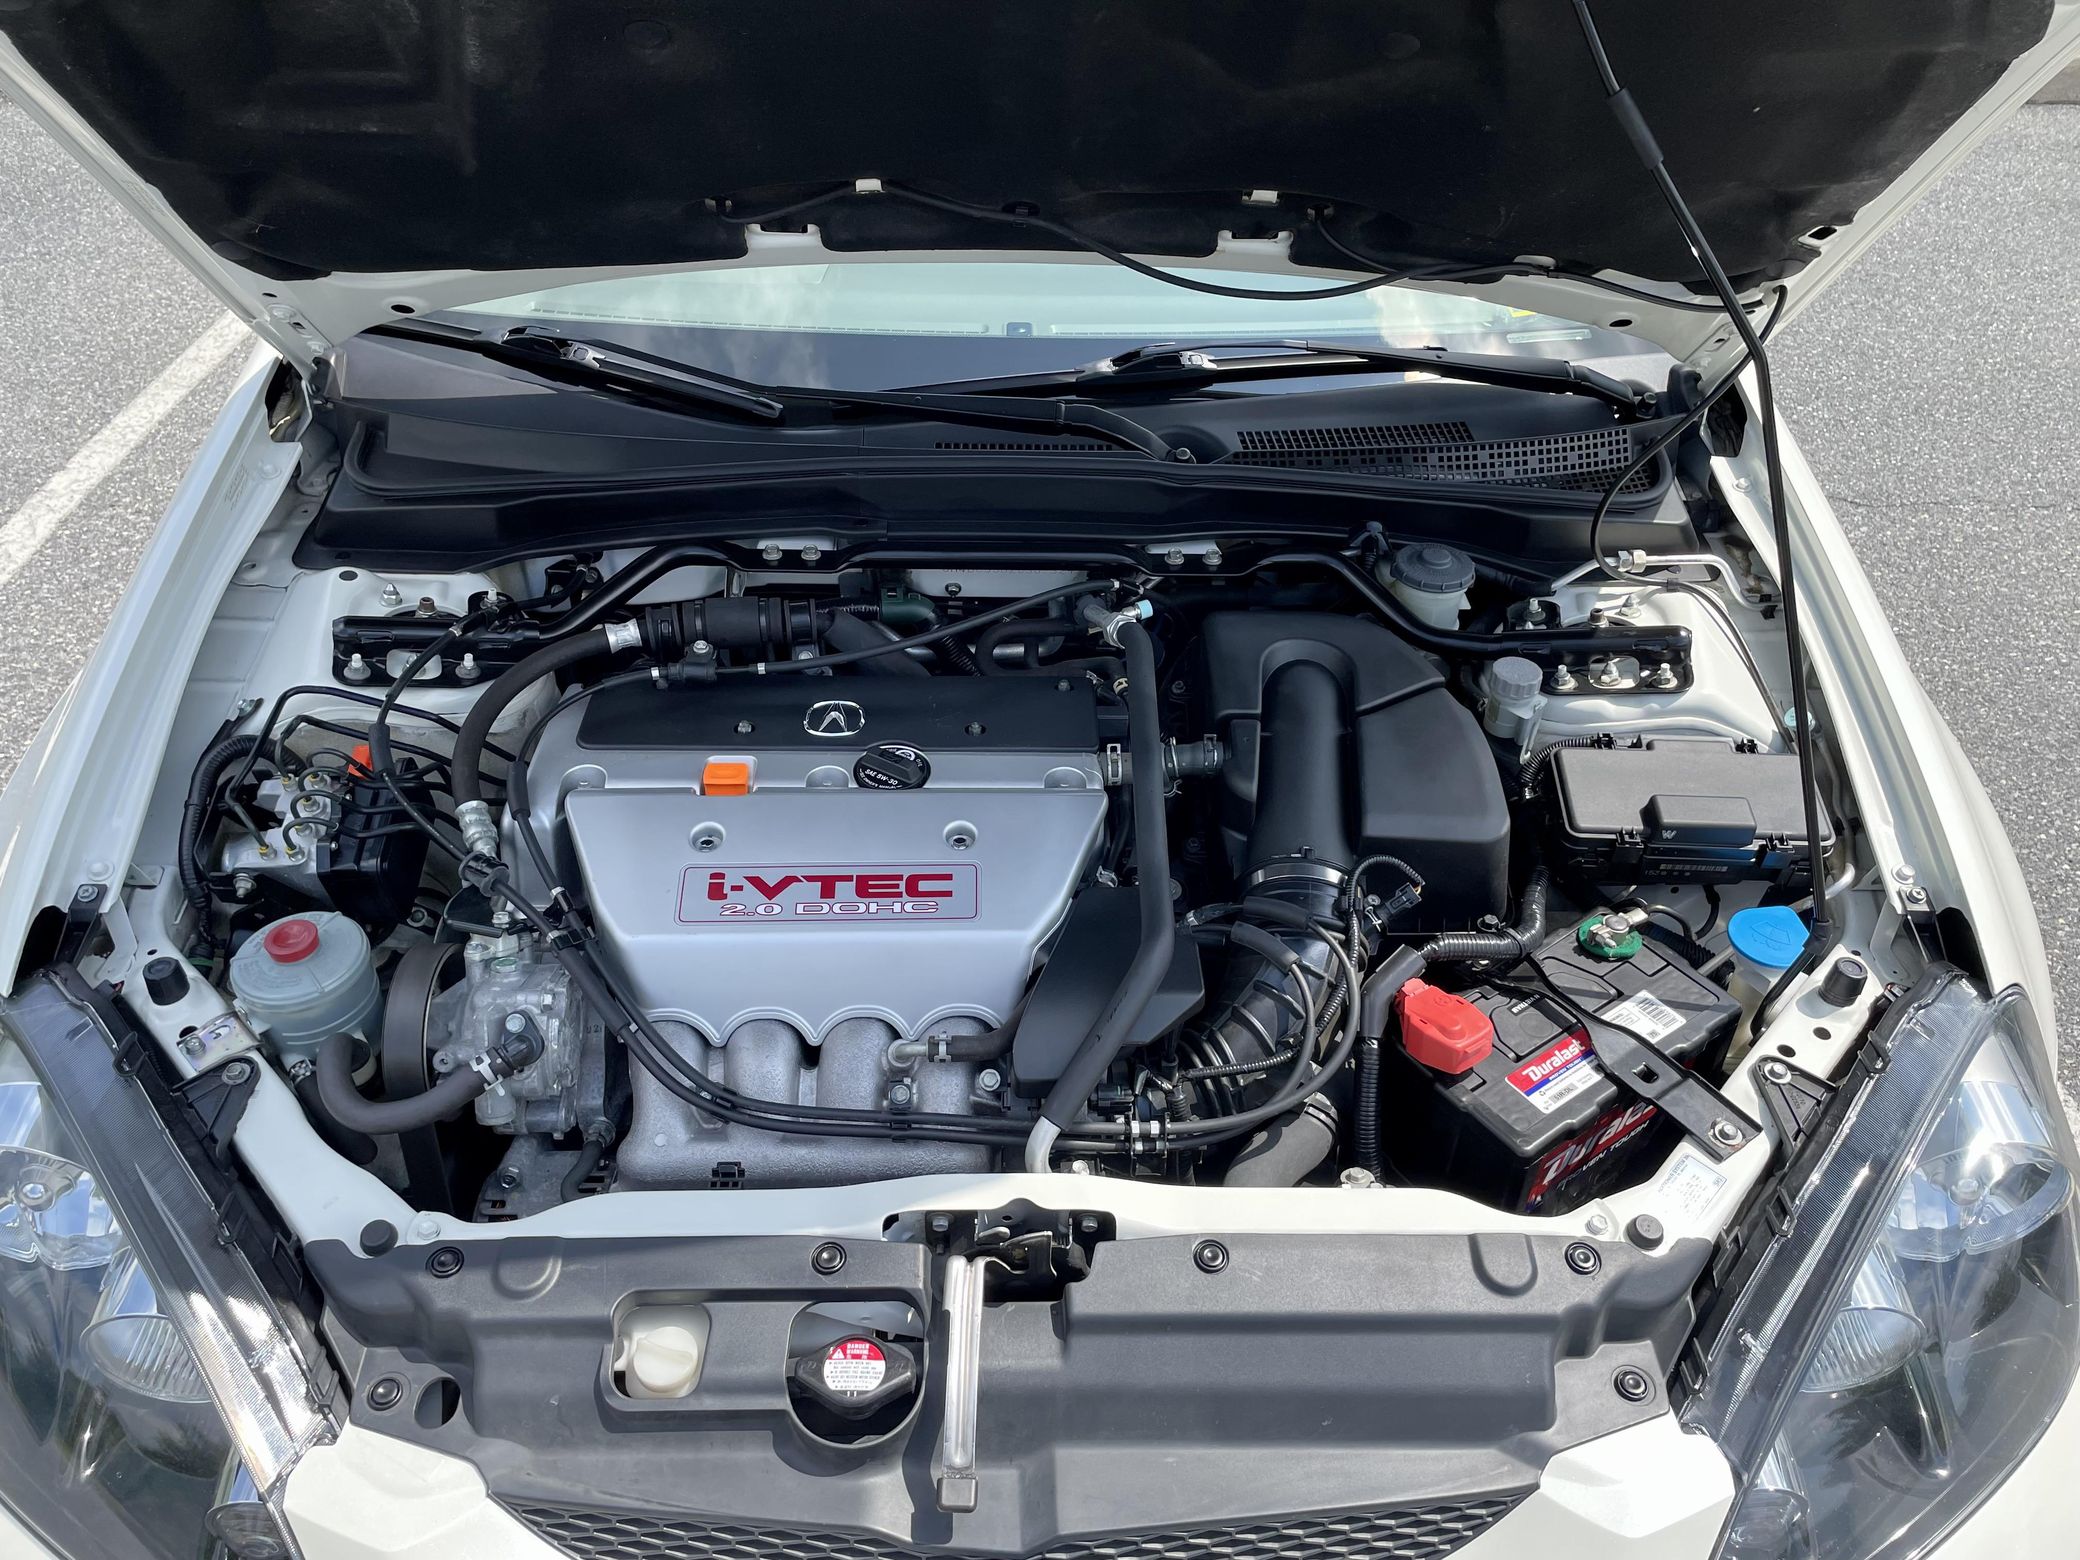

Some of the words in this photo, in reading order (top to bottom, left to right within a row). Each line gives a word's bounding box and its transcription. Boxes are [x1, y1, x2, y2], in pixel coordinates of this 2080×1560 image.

[865, 769, 877, 777] SAE
[876, 774, 898, 785] 5W-30
[707, 872, 953, 901] i-VTEC
[720, 903, 783, 916] 2.0
[795, 901, 938, 915] DOHC
[1521, 1039, 1585, 1082] Duralast
[1557, 1150, 1607, 1190] PROVEN
[1609, 1120, 1650, 1152] TOUGH
